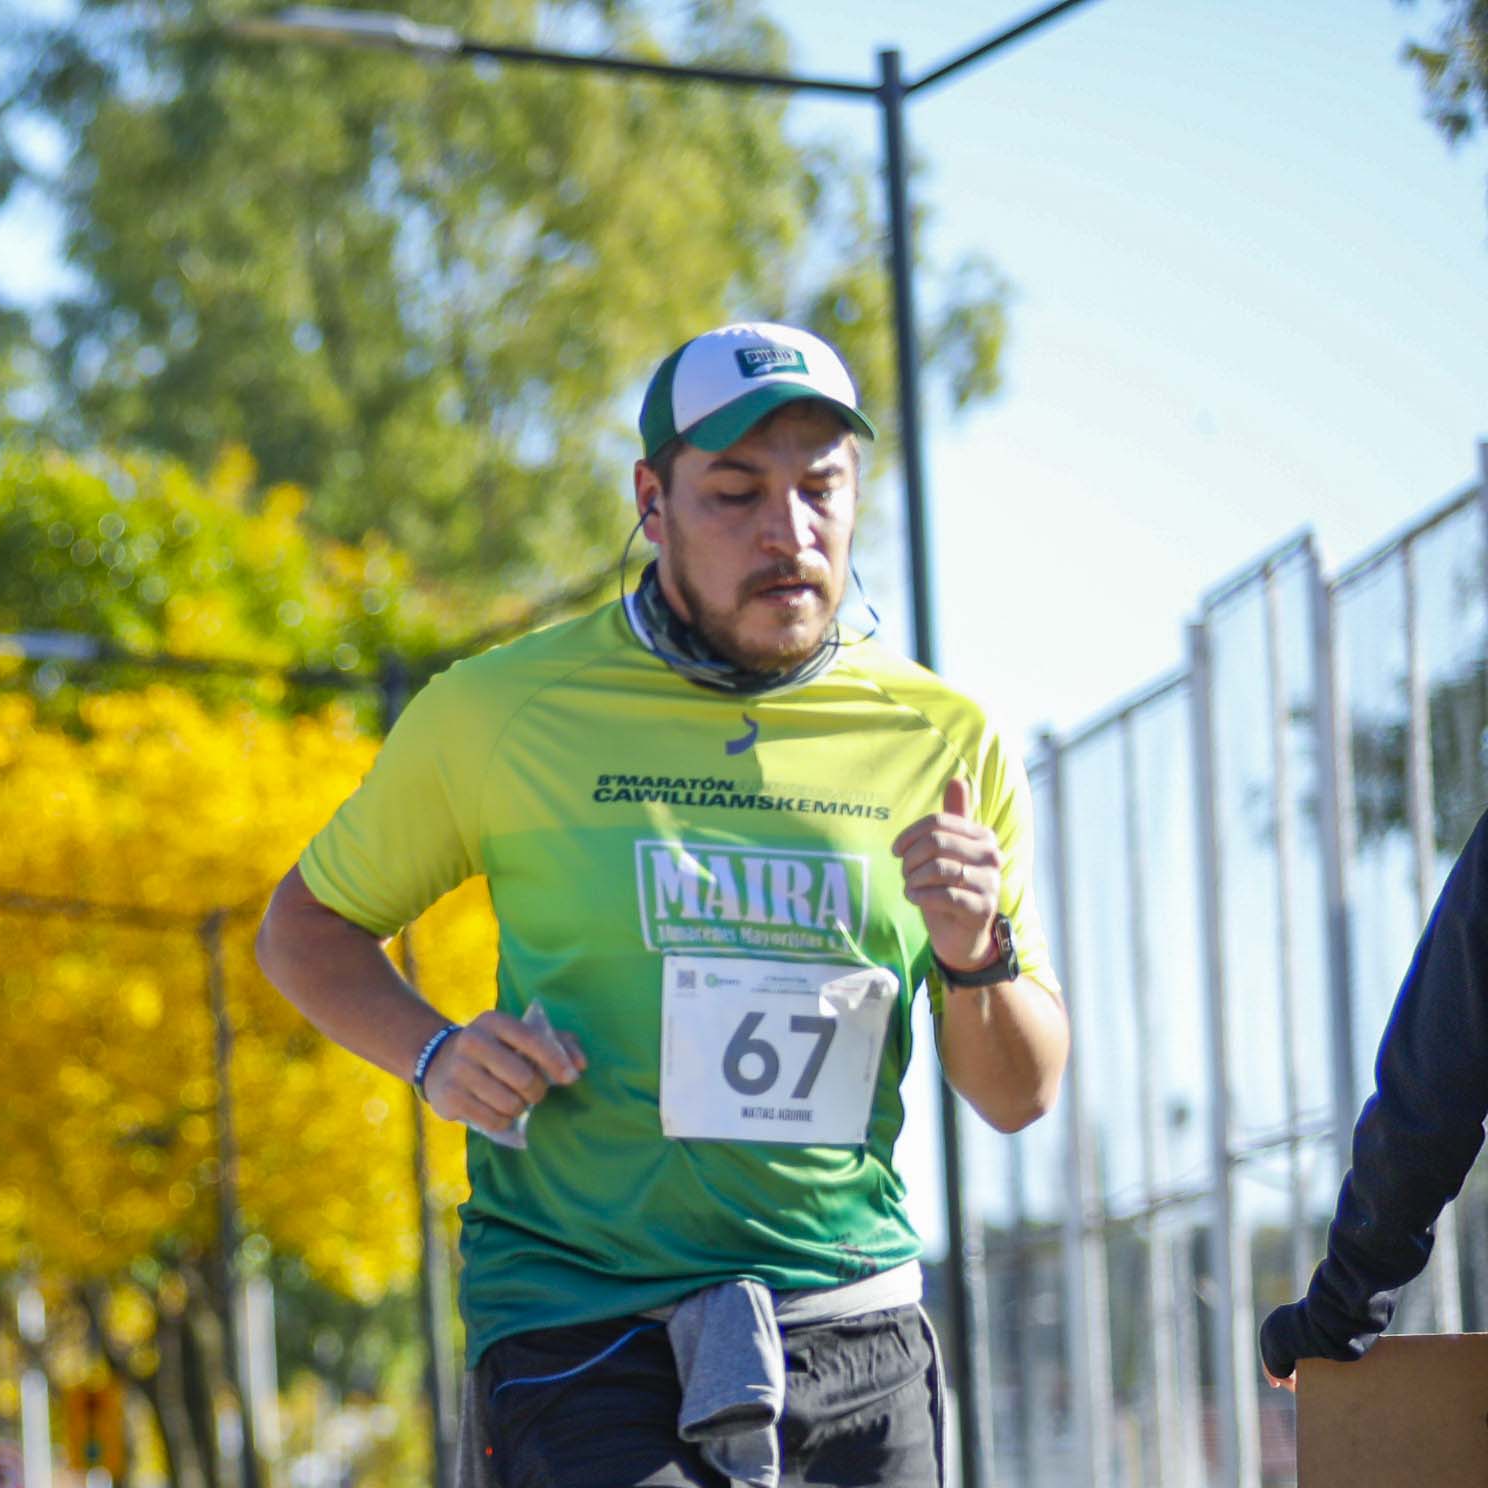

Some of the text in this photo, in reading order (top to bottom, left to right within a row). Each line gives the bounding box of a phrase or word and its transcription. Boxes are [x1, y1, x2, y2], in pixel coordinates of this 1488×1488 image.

[592, 787, 891, 821] CAWILLIAMSKEMMIS
[649, 849, 854, 932] MAIRA
[722, 1011, 837, 1099] 67
